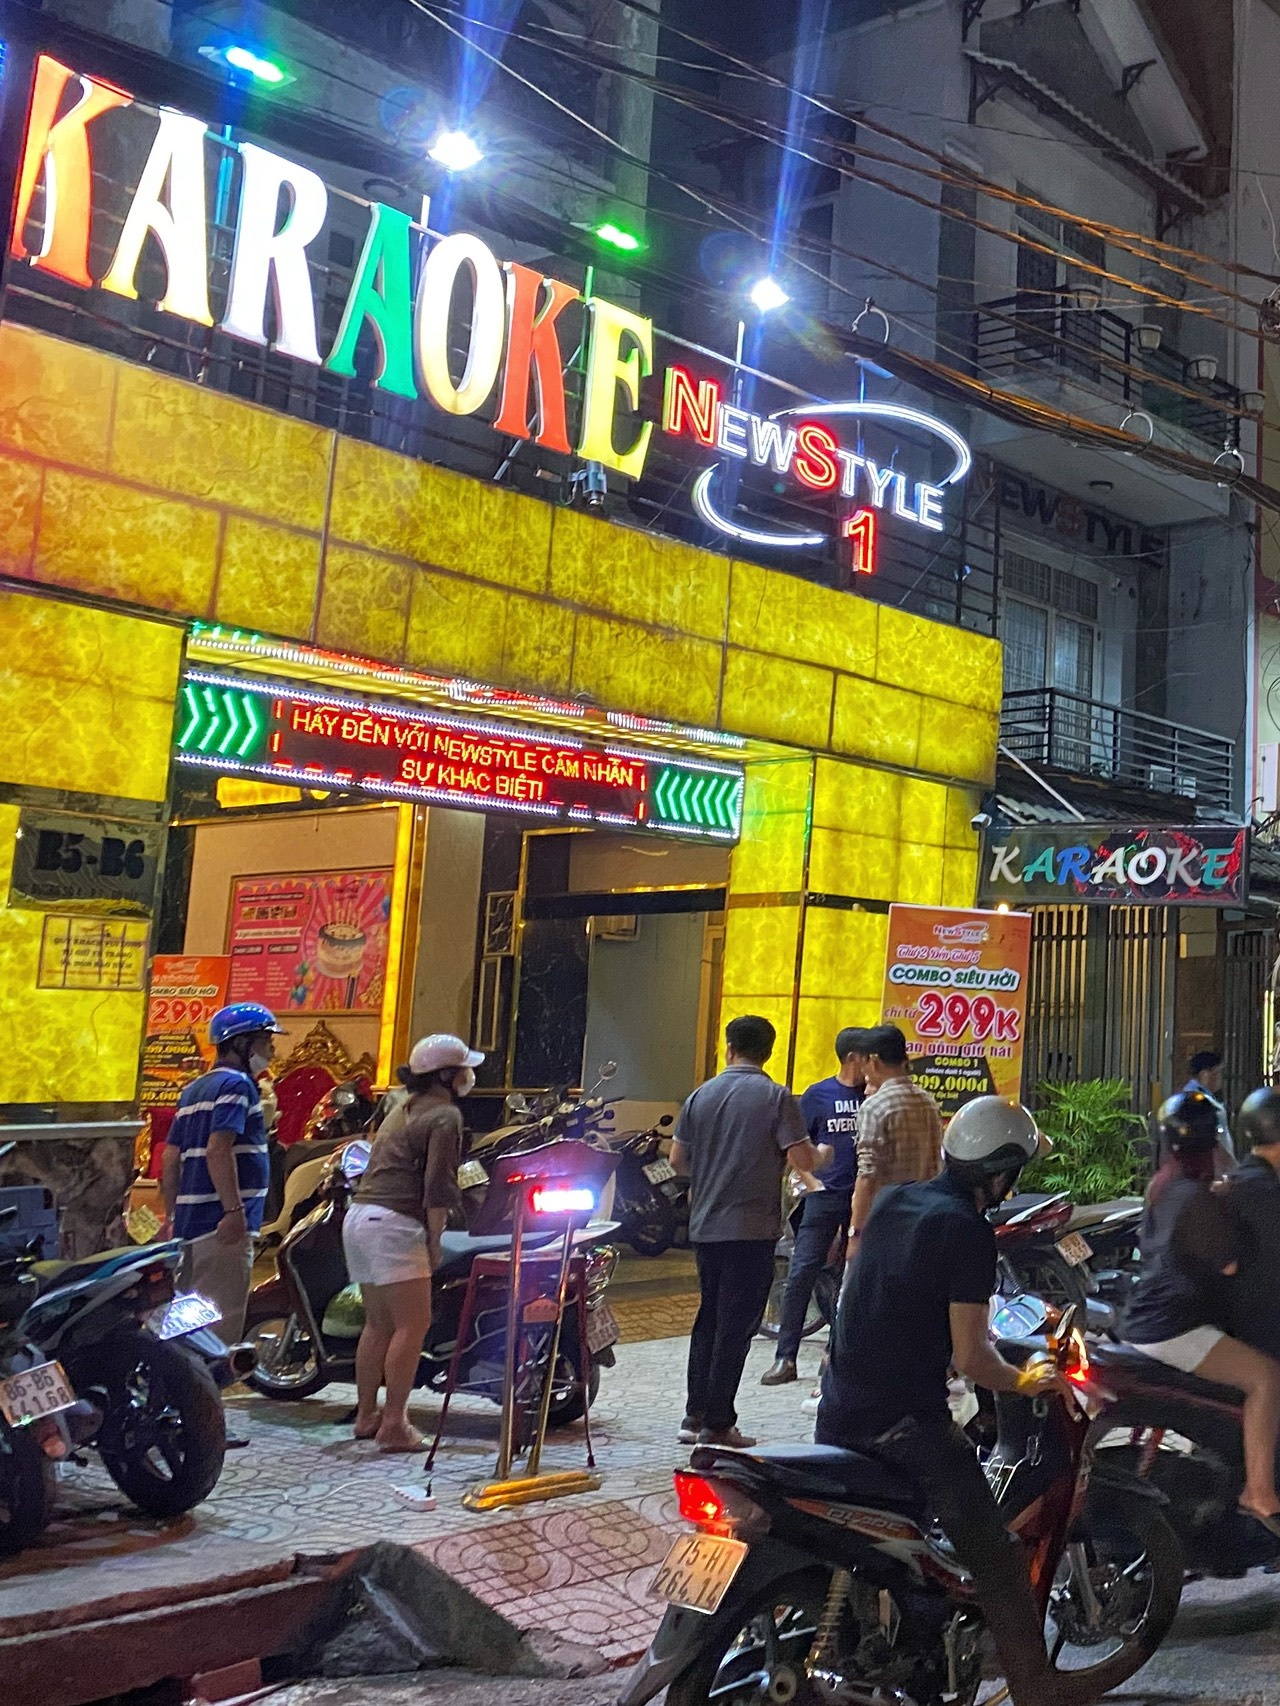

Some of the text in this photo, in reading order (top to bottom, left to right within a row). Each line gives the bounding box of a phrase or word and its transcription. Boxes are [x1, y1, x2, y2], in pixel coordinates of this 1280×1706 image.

[10, 53, 654, 482] KARAOKE
[842, 508, 877, 575] 1
[433, 733, 538, 773] NEWSTYLE
[989, 844, 1236, 890] KARAOKE
[892, 967, 951, 983] COMBO
[955, 969, 985, 986] SIÊU
[917, 991, 1019, 1040] 299K
[934, 1057, 971, 1067] COMBO
